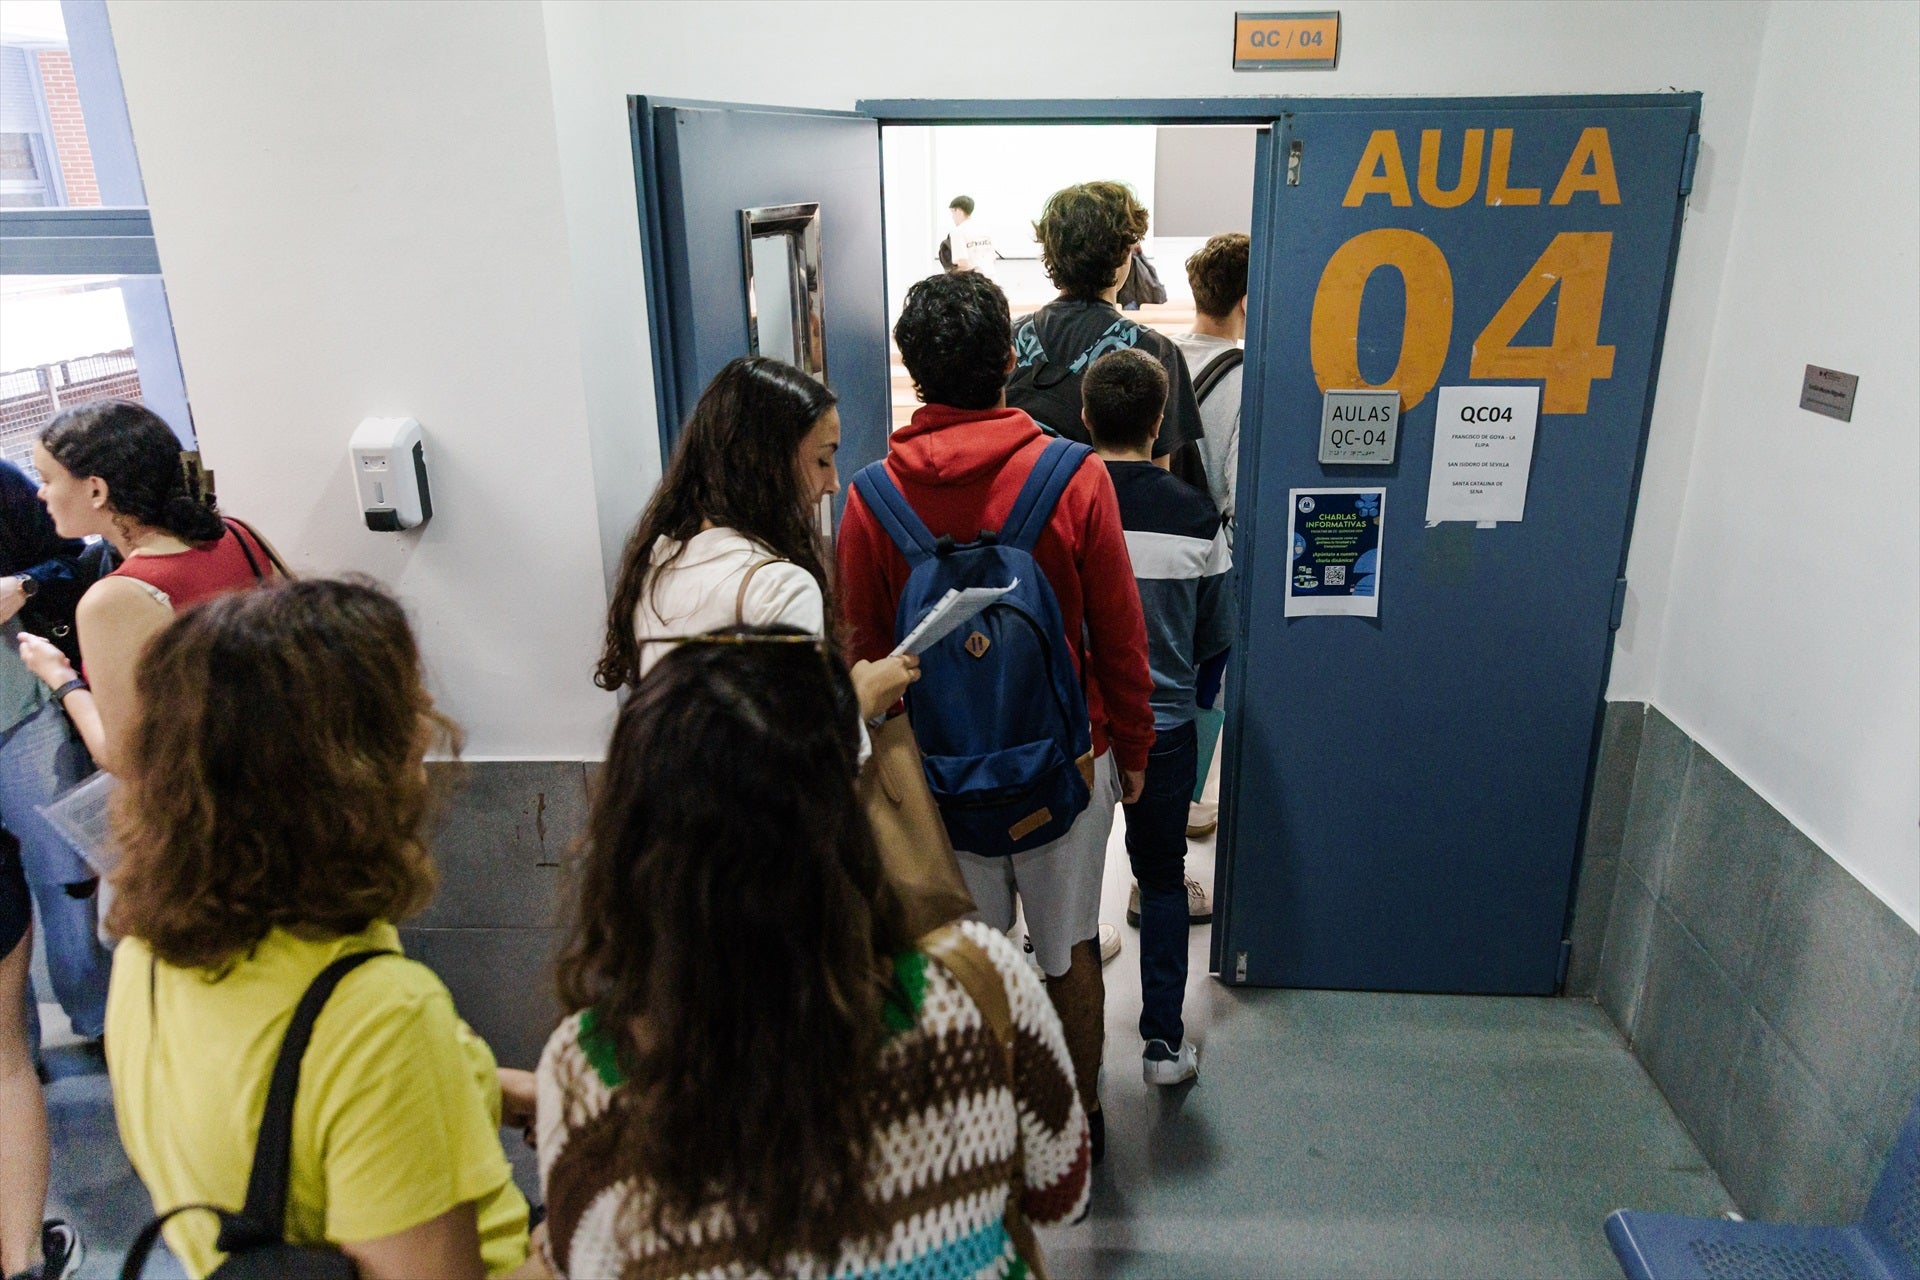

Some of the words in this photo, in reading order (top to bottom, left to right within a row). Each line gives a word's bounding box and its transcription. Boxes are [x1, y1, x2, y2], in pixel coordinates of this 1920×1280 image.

[1250, 29, 1281, 48] QC
[1285, 30, 1294, 49] /
[1299, 30, 1323, 47] 04
[1341, 127, 1622, 208] AULA
[1310, 228, 1616, 414] 04
[1331, 405, 1390, 422] AULAS
[1460, 406, 1513, 424] QC04
[1331, 429, 1386, 448] QC-04
[1305, 520, 1367, 528] INFORMATIVAS
[1318, 513, 1357, 521] CHARLAS
